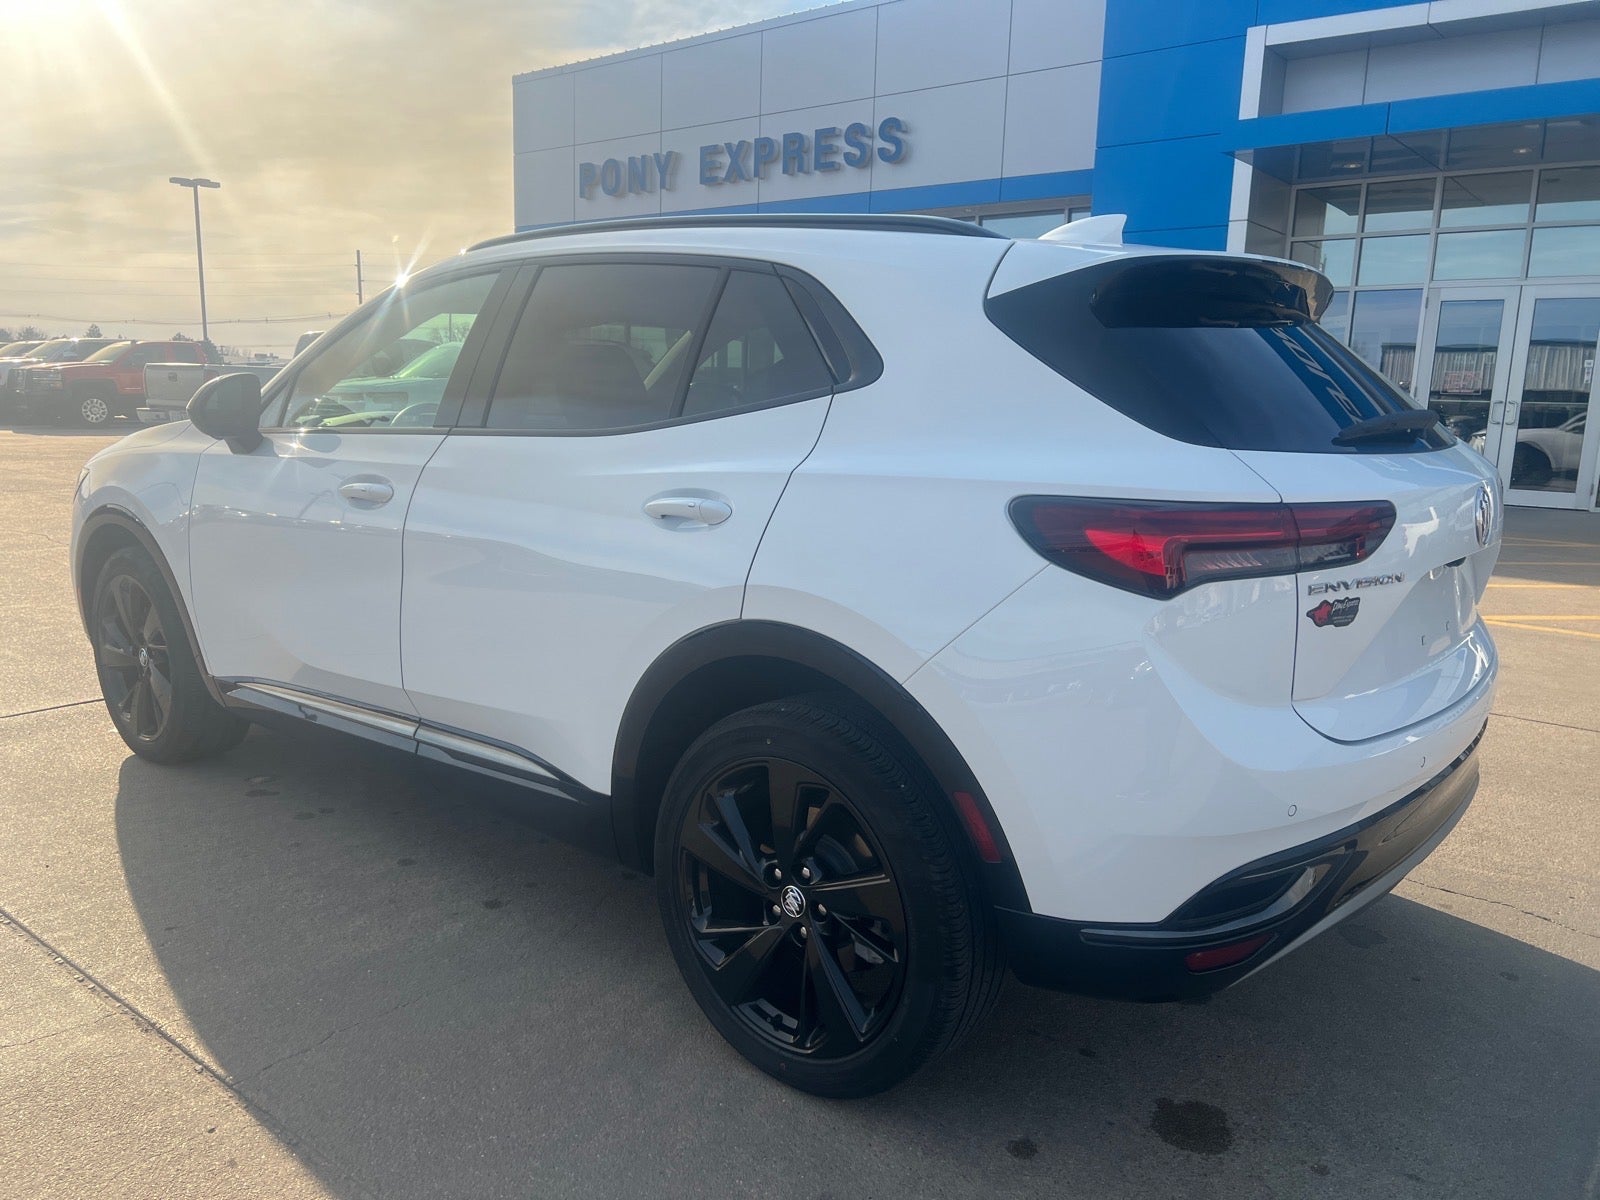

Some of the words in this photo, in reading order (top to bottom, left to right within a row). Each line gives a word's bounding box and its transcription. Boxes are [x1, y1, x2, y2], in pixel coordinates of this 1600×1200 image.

[579, 151, 680, 199] PONY
[699, 116, 907, 187] EXPRESS
[1307, 572, 1405, 595] ENVISION
